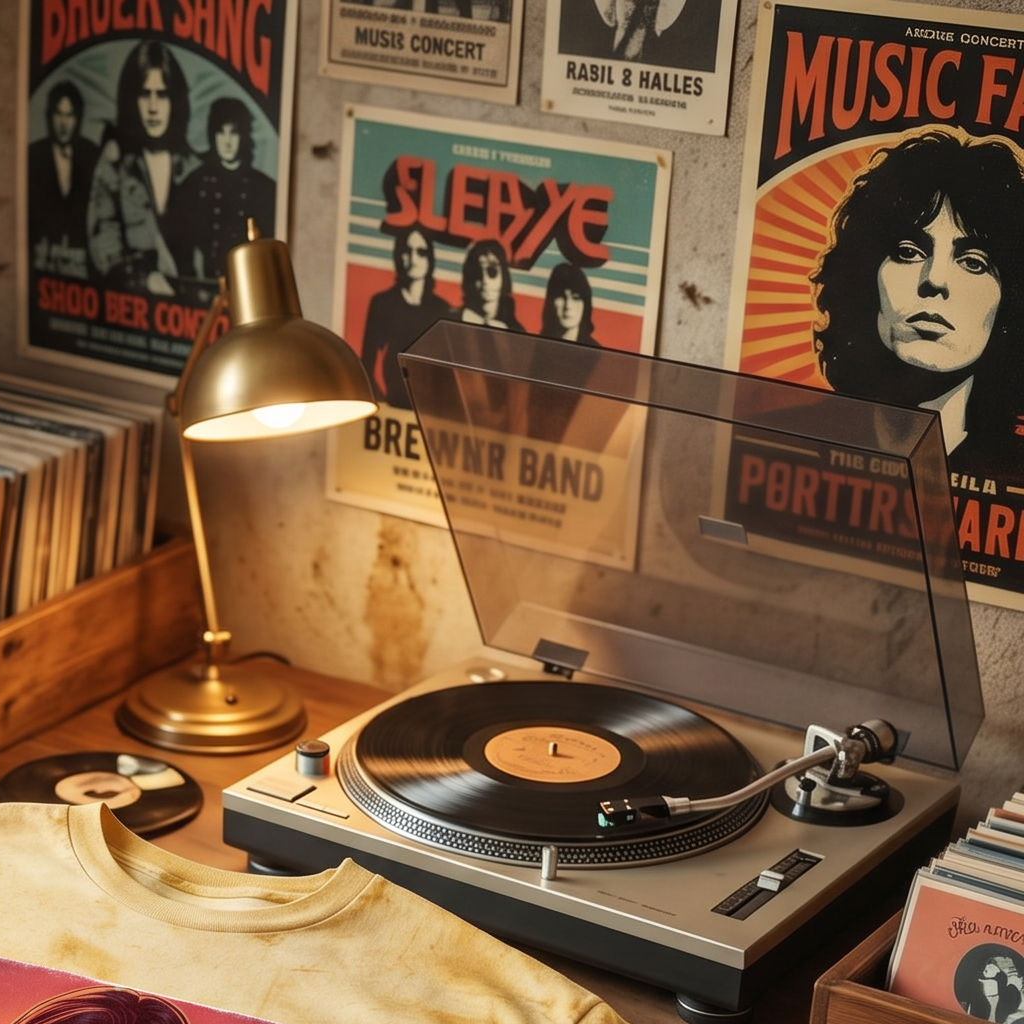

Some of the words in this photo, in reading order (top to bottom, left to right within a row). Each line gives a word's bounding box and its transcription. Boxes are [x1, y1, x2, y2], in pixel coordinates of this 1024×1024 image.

[410, 34, 486, 61] CONCERT
[639, 70, 704, 97] HALLES
[774, 31, 963, 160] MUSIC
[518, 446, 604, 503] BAND
